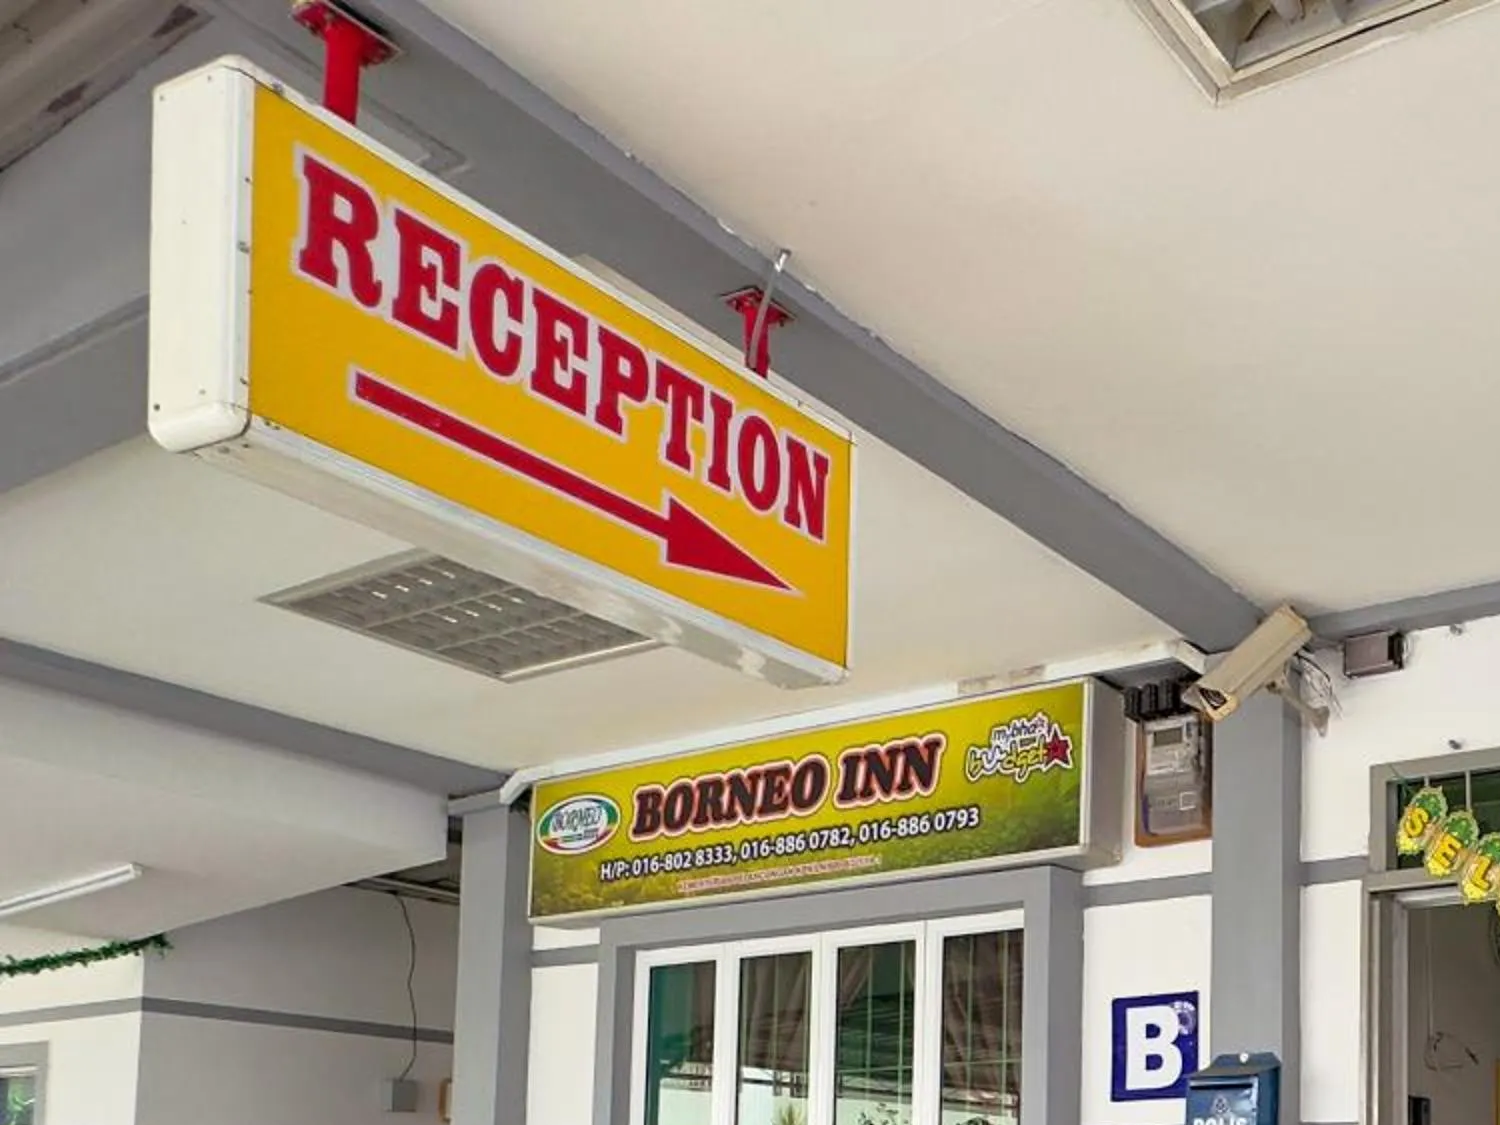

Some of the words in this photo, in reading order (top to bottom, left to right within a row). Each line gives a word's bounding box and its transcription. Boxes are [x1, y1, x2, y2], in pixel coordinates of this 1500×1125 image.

[299, 153, 830, 542] RECEPTION
[632, 759, 826, 836] BORNEO
[837, 738, 944, 802] INN
[600, 861, 630, 881] H/P:
[632, 852, 692, 876] 016-802
[694, 845, 737, 866] 8333,
[741, 835, 806, 860] 016-886
[809, 827, 856, 850] 0782,
[859, 815, 931, 842] 016-886
[934, 807, 980, 832] 0793
[1125, 1004, 1183, 1092] B
